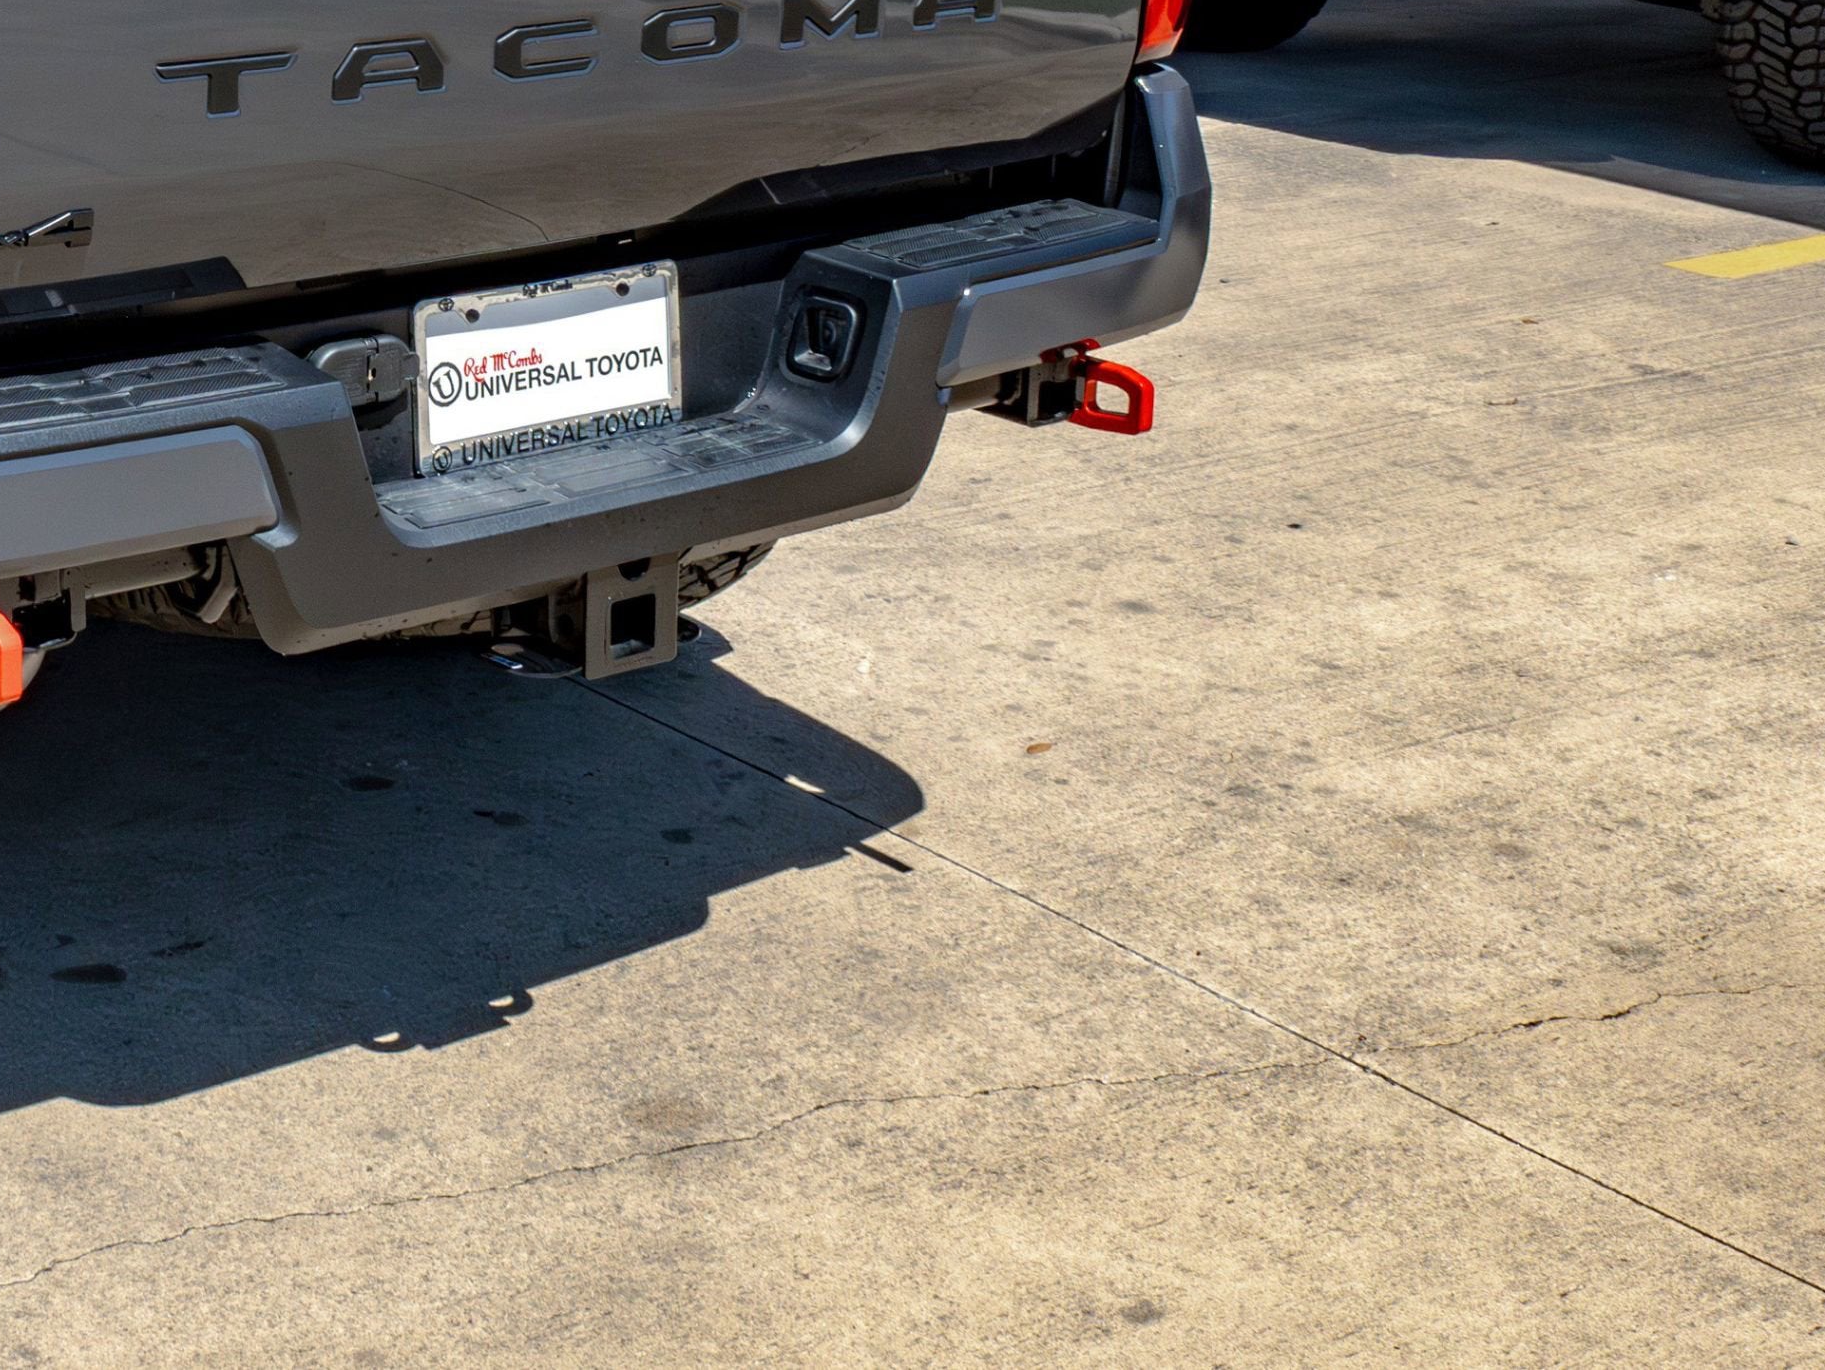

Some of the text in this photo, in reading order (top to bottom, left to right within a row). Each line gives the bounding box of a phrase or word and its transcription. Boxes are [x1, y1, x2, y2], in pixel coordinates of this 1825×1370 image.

[464, 347, 543, 383] Red McCombs
[464, 346, 664, 401] UNIVERSAL TOYOTA
[461, 403, 674, 465] UNIVERSAL TOYOTA
